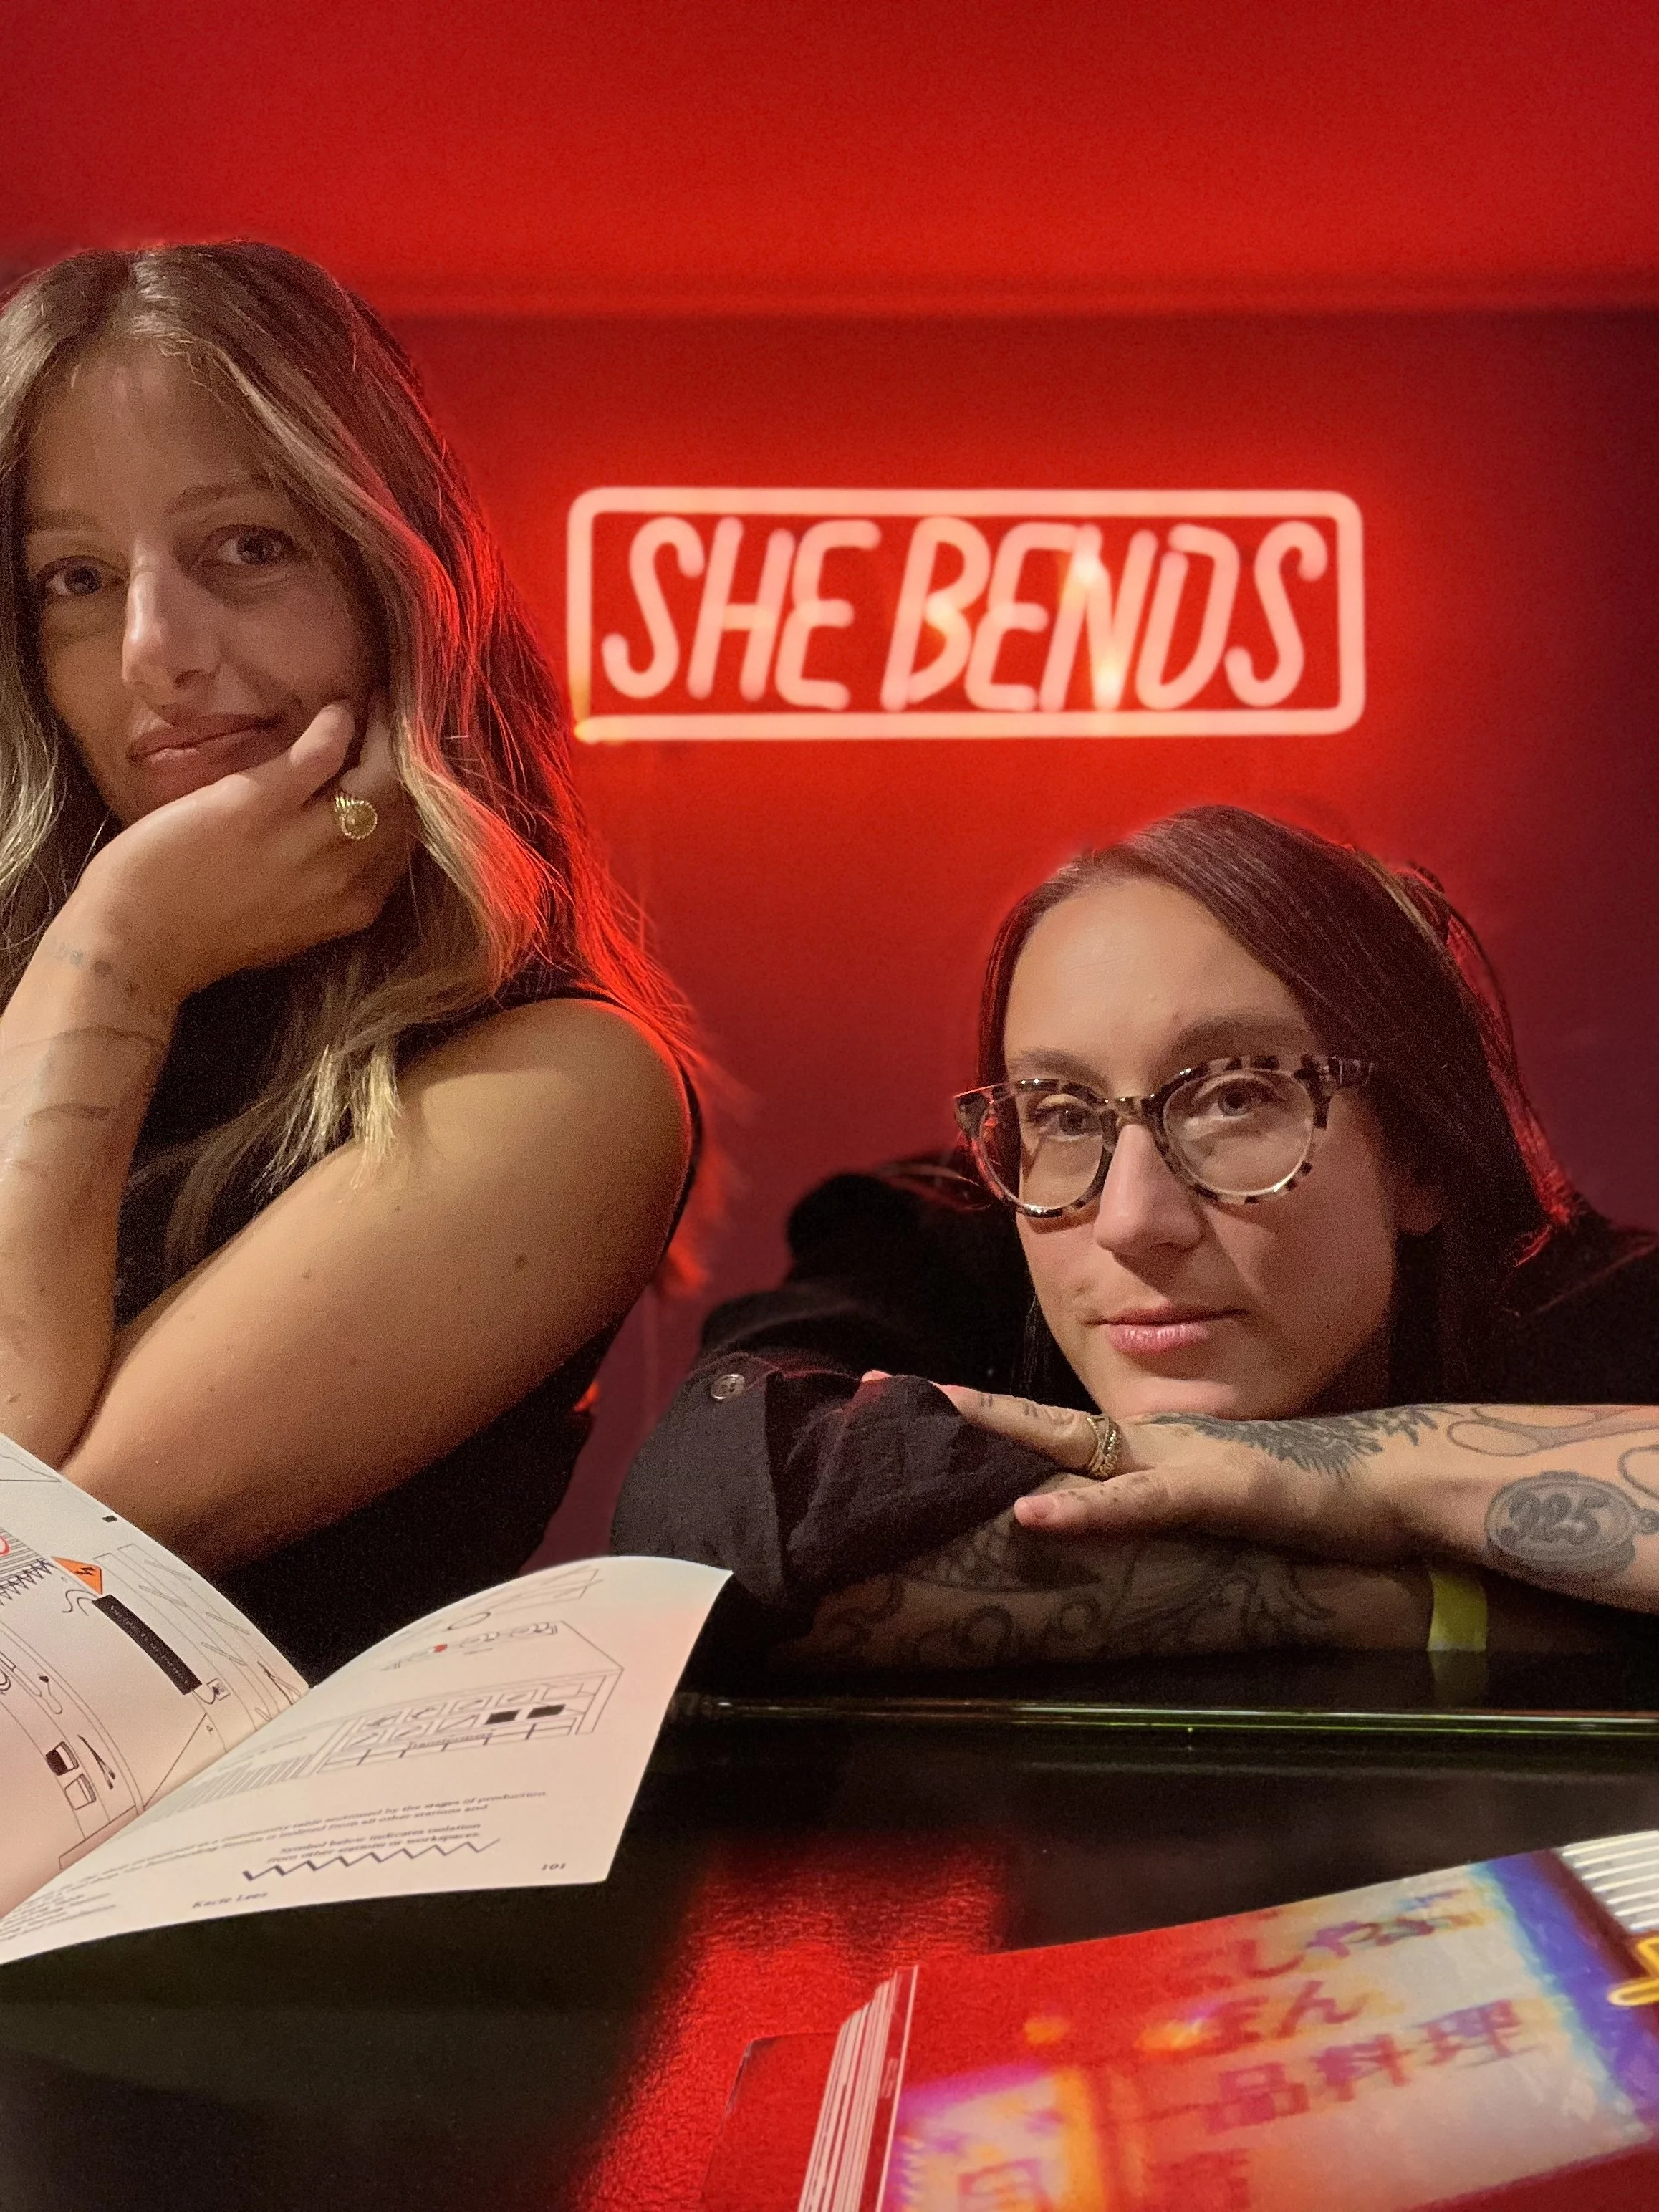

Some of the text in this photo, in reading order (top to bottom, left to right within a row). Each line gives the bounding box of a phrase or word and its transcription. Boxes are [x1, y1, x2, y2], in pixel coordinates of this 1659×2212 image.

[601, 516, 1328, 713] SHE BENDS
[402, 1804, 421, 1812] the
[424, 1799, 460, 1809] stages
[477, 1791, 547, 1804] production
[327, 1821, 359, 1831] from
[378, 1813, 411, 1823] other
[414, 1808, 462, 1818] stations
[464, 1804, 489, 1812] and
[280, 1824, 481, 1853] Symbol below indicates isolation
[266, 1854, 298, 1863] from
[300, 1849, 335, 1859] other
[337, 1842, 386, 1853] stations
[541, 1862, 567, 1871] 101
[235, 1892, 269, 1902] Lees
